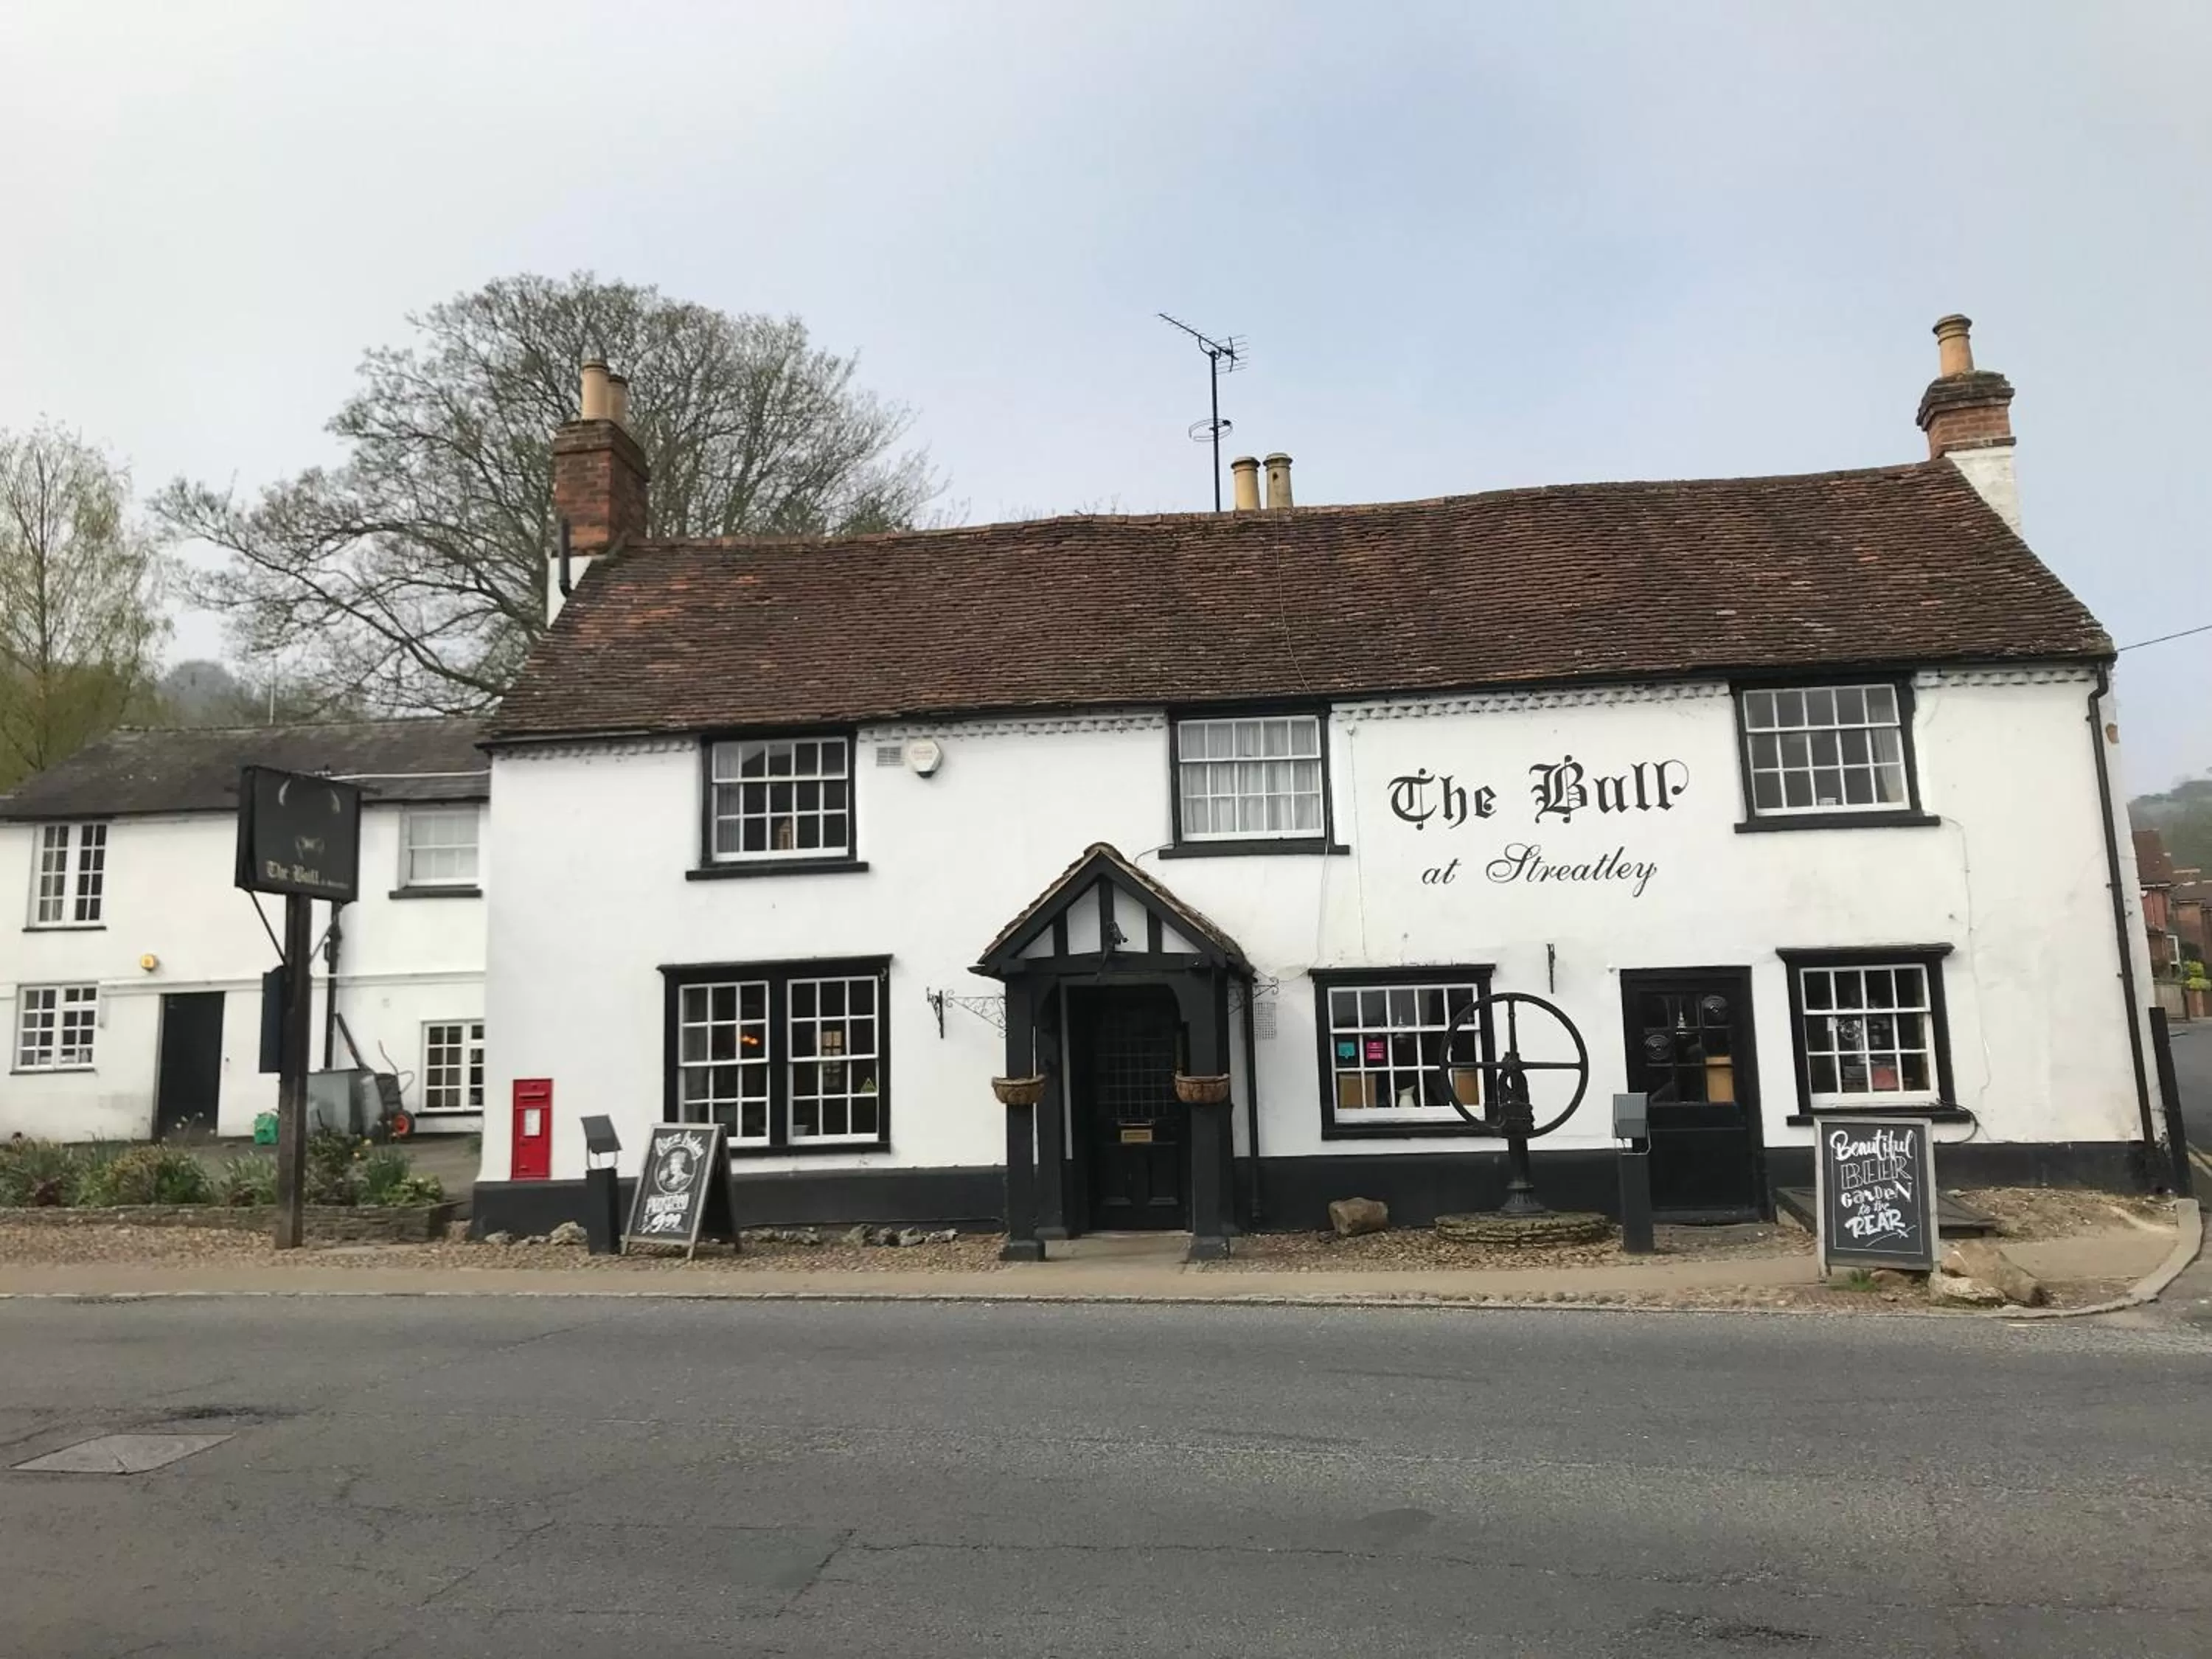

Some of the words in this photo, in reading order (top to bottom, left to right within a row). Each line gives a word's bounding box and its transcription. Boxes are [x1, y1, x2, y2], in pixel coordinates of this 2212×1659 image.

[1387, 768, 1498, 830] The
[1528, 754, 1689, 824] Bull
[266, 860, 289, 880] The
[1422, 858, 1462, 885] at
[1485, 843, 1658, 898] Streatley
[1829, 1130, 1914, 1161] Beautiful
[1840, 1155, 1913, 1190] BEER
[1844, 1208, 1906, 1239] REAR
